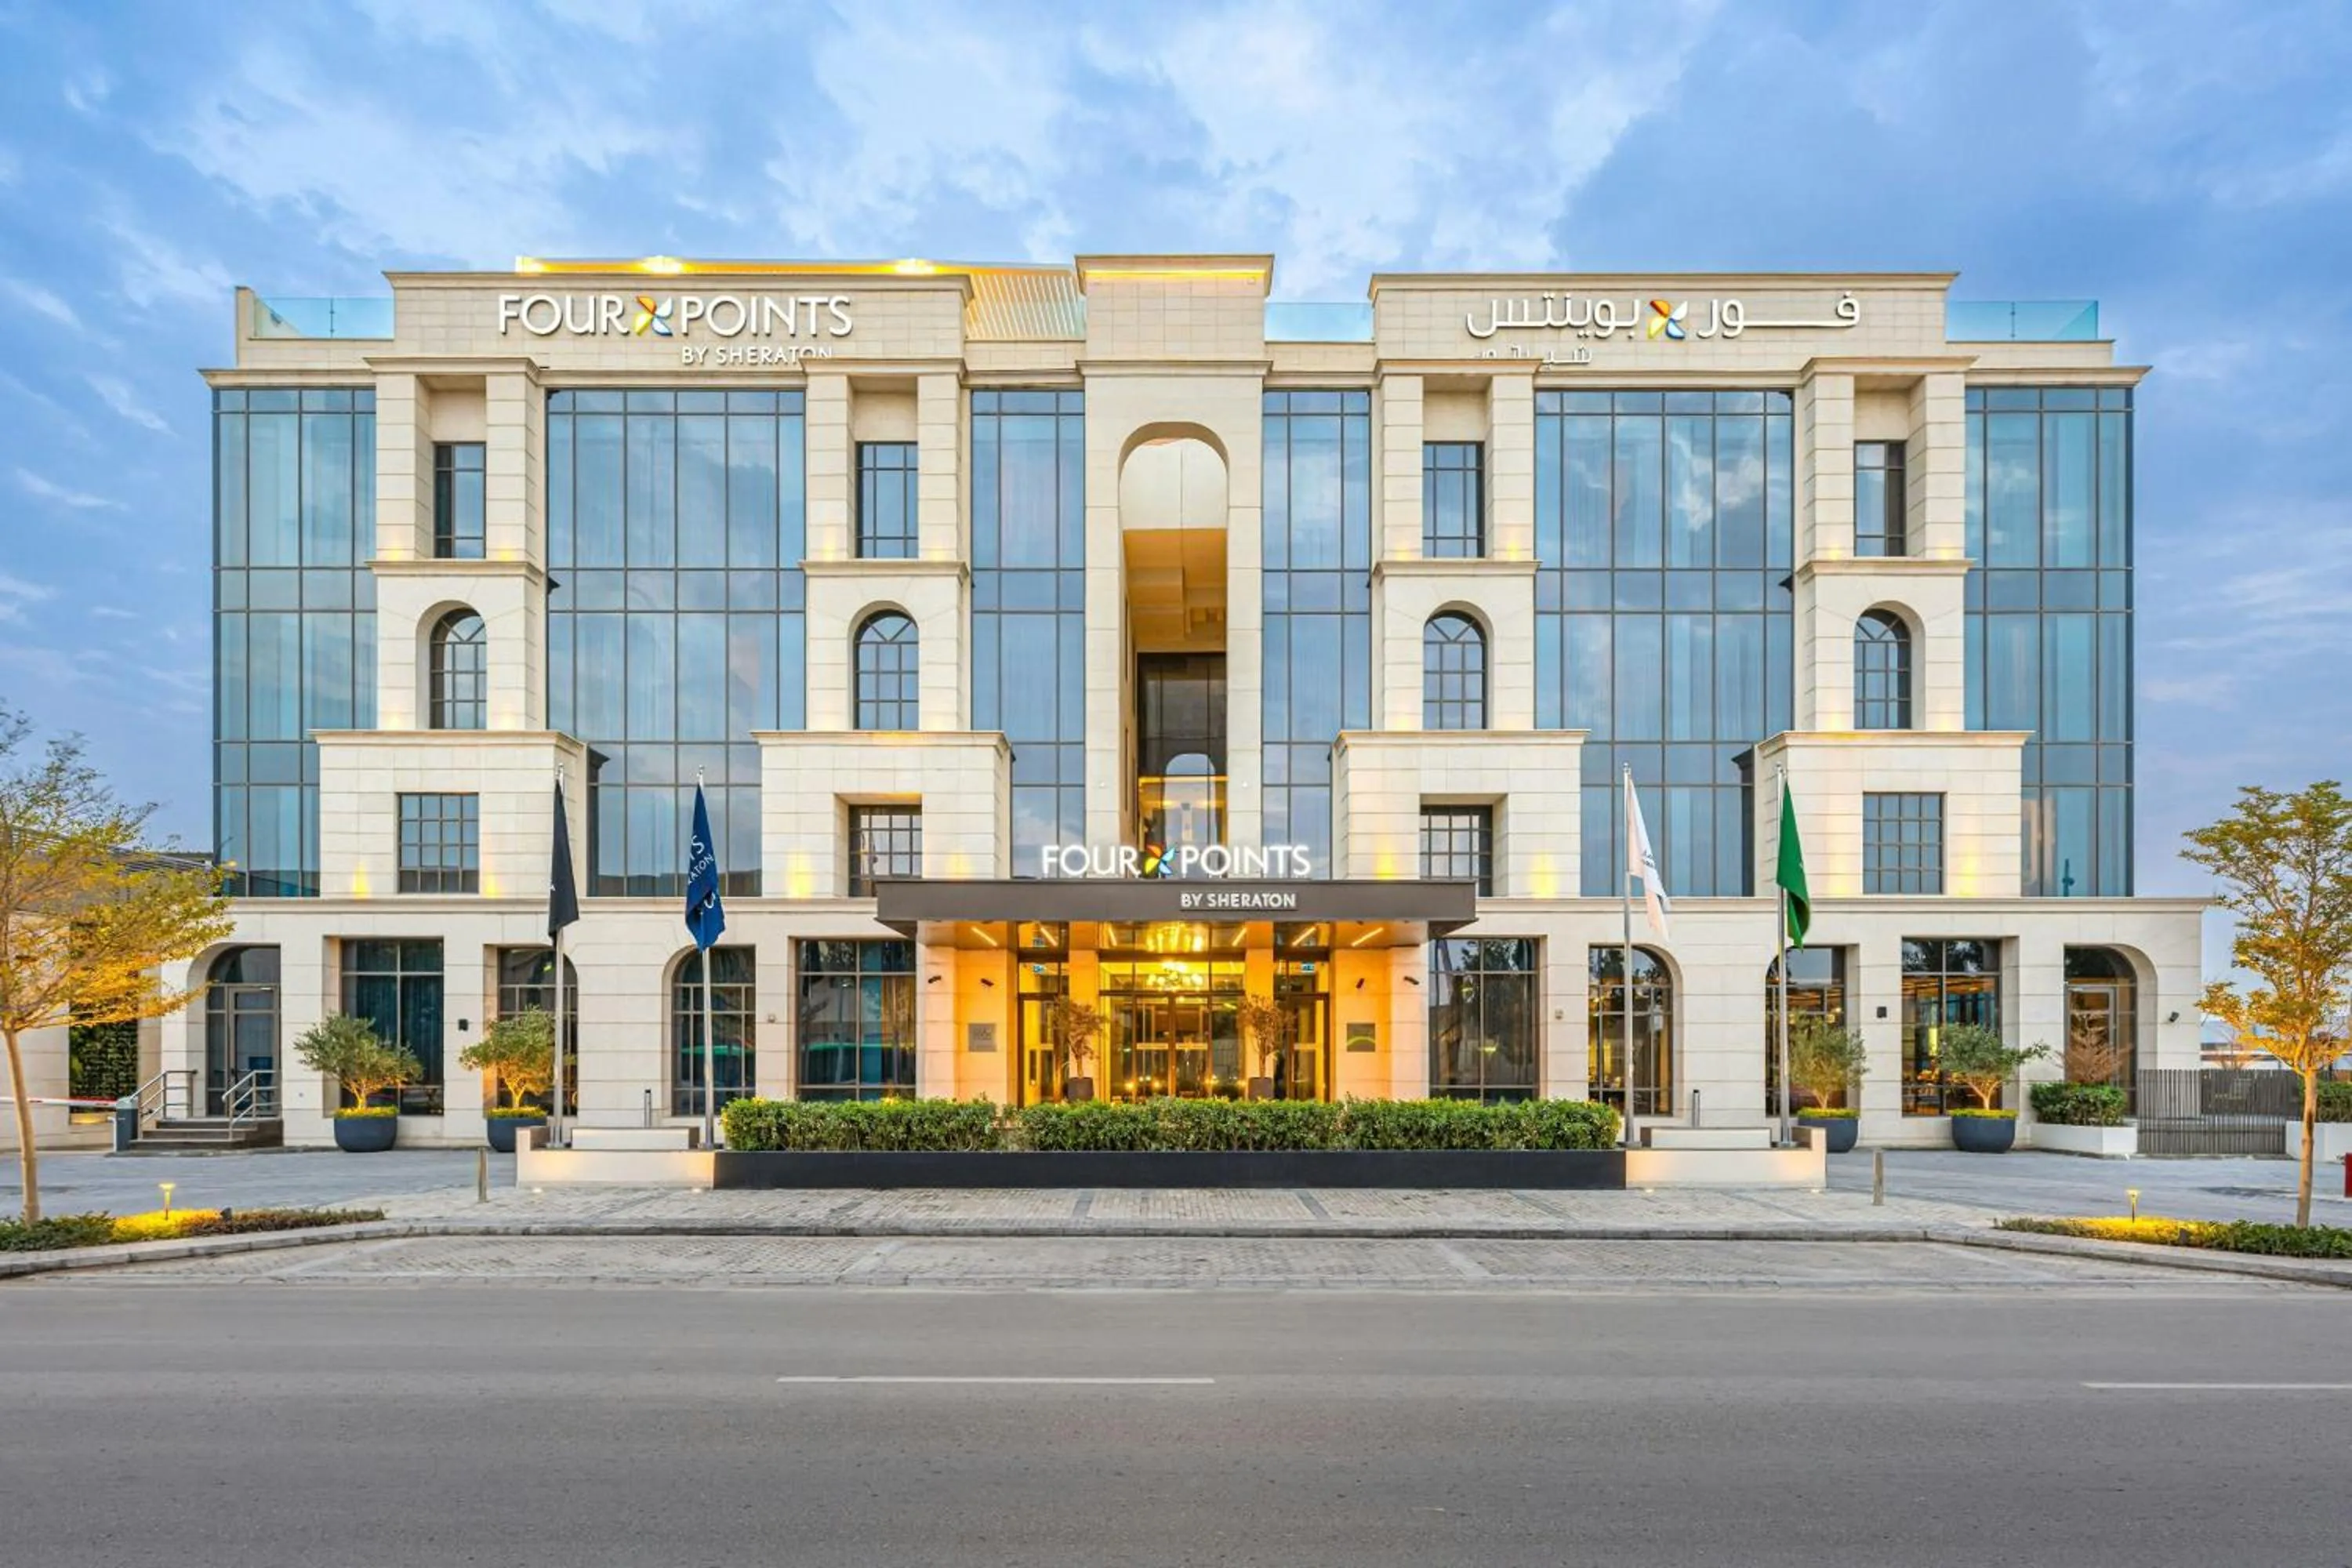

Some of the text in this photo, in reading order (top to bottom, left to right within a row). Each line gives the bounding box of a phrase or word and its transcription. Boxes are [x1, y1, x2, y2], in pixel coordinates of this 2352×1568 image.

[498, 294, 853, 337] FOUR POINTS
[1466, 292, 1641, 338] بوينتس
[681, 346, 833, 365] BY SHERATON
[1041, 844, 1312, 877] FOUR POINTS
[1180, 892, 1297, 908] BY SHERATON
